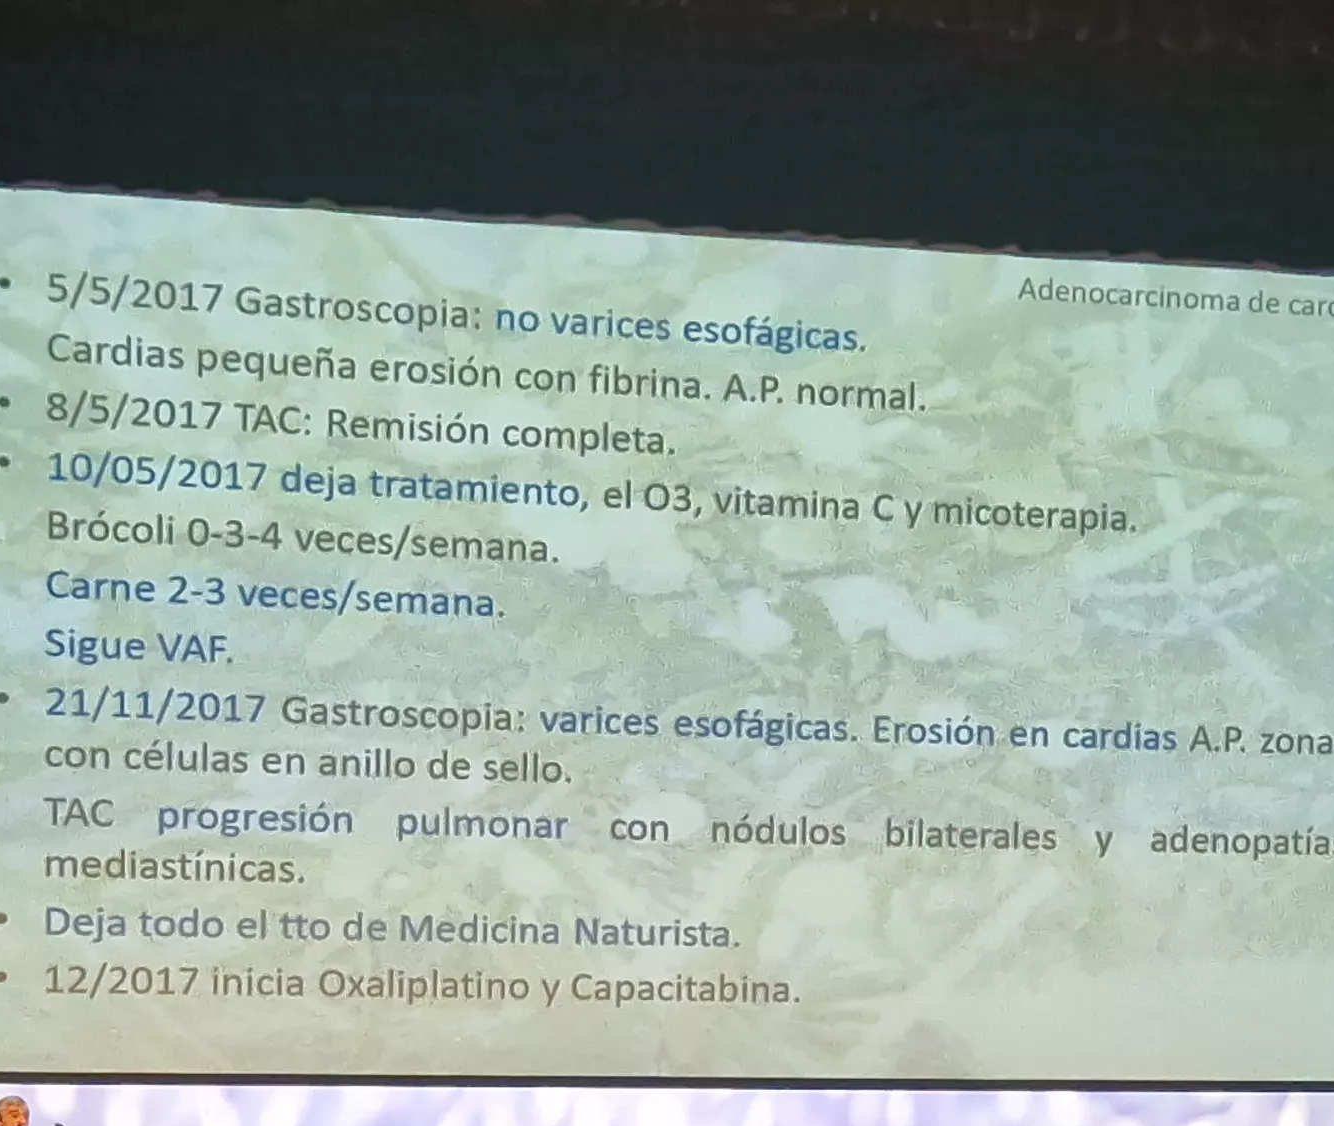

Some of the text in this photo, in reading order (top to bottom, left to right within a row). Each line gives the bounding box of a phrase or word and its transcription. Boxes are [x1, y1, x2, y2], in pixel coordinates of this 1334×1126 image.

[47, 270, 866, 355] 5/5/2017 Gastroscopia: no varices esofágicas.
[1017, 276, 1241, 312] Adenocarcinoma
[1247, 289, 1281, 315] de
[47, 333, 926, 412] Cardias pequeña erosión con fibrina. A.P. normal.
[46, 389, 675, 458] 8/5/2017 TAC: Remisión completa.
[49, 450, 1137, 538] 10/05/2017 deja tratamiento, el O3, vitamina C y micoterapia.
[48, 509, 559, 564] Brócoli 0-3-4 veces/semana.
[45, 569, 505, 618] Carne 2-3 veces/semana.
[44, 628, 233, 666] Sigue VAF.
[46, 685, 266, 726] 21/11/2017
[281, 695, 525, 738] Gastroscopia:
[539, 705, 659, 737] varices
[673, 708, 858, 747] esofágicas.
[873, 715, 995, 747] Erosión
[1008, 725, 1049, 748] en
[1062, 721, 1178, 752] cardias
[1189, 724, 1246, 754] A.P.
[44, 739, 572, 784] con células en anillo de sello.
[42, 796, 114, 828] TAC
[157, 801, 353, 839] progresión
[397, 805, 569, 842] pulmonar
[610, 818, 669, 842] con
[711, 813, 846, 846] nódulos
[885, 816, 1057, 852] bilaterales
[1094, 830, 1114, 858] y
[45, 848, 305, 884] mediastínicas.
[45, 906, 740, 948] Deja todo el tto de Medicina Naturista.
[45, 961, 800, 1008] 12/2017 inicia Oxaliplatino y Capacitabina.
